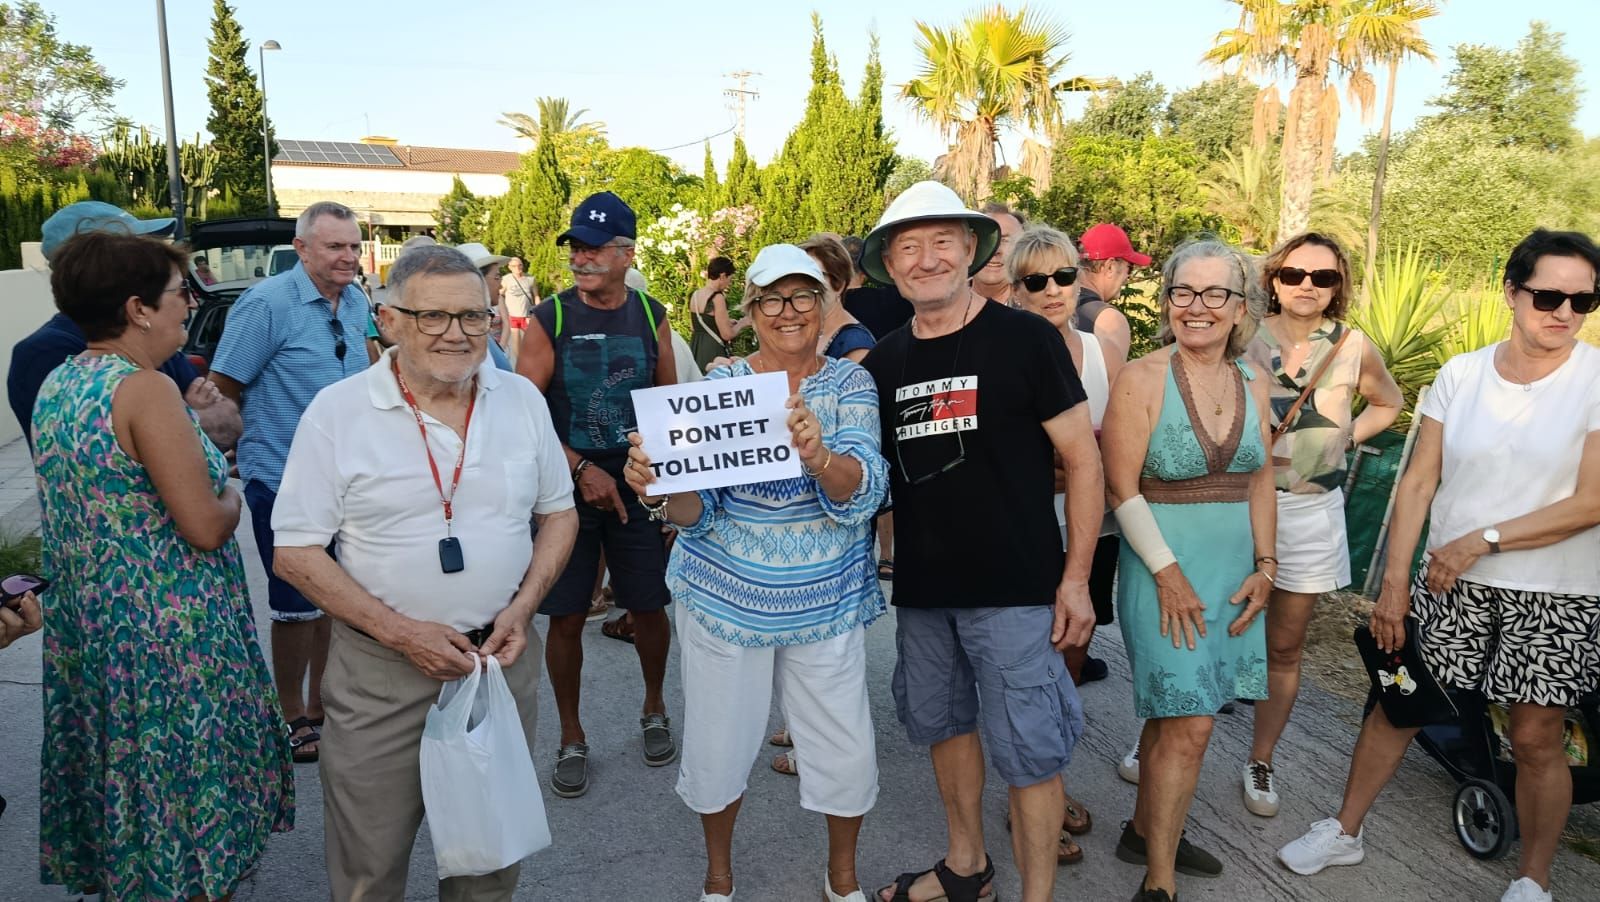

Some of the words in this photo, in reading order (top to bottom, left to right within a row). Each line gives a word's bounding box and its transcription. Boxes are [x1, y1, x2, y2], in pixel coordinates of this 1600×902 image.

[667, 389, 755, 415] VOLEM
[902, 379, 968, 398] TOMMY
[669, 418, 769, 446] PONTET
[649, 445, 791, 478] TOLLINERO
